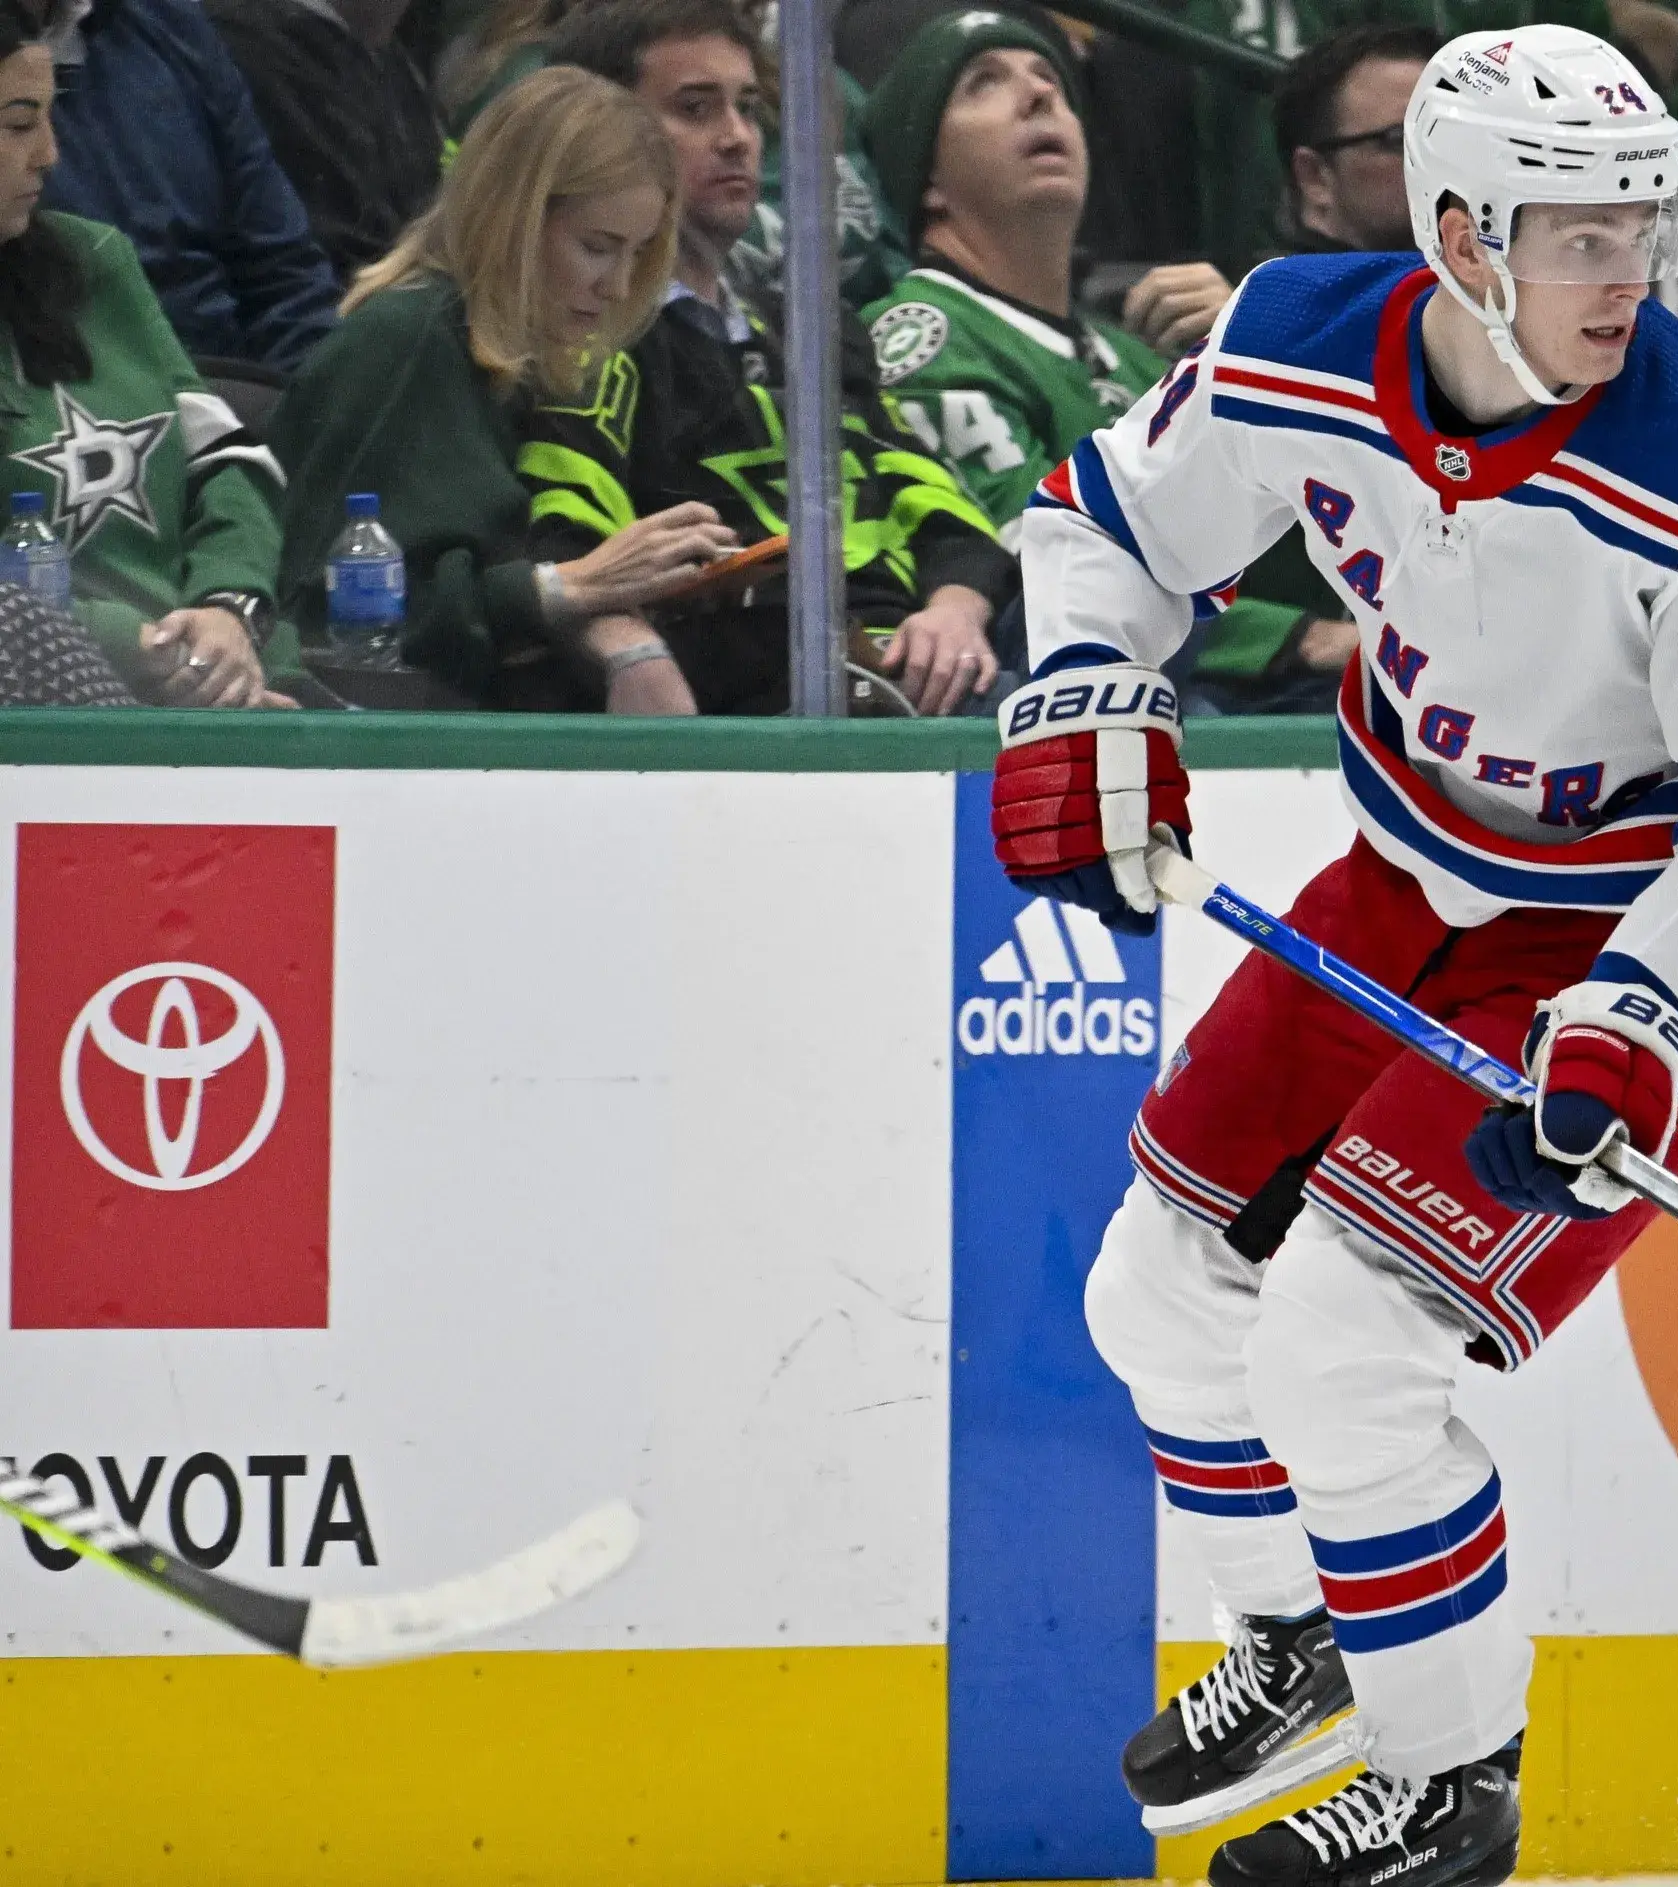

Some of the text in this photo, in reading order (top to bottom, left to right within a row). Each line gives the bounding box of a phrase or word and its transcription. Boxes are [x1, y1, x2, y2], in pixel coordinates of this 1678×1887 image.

[1455, 67, 1493, 95] Moore
[1459, 50, 1511, 87] Benjamin
[1594, 81, 1647, 115] 24
[1444, 457, 1463, 470] NHL
[1304, 478, 1664, 829] RANGER
[1008, 682, 1181, 738] BAUE
[958, 979, 1155, 1056] adidas
[0, 1451, 379, 1572] OYOTA
